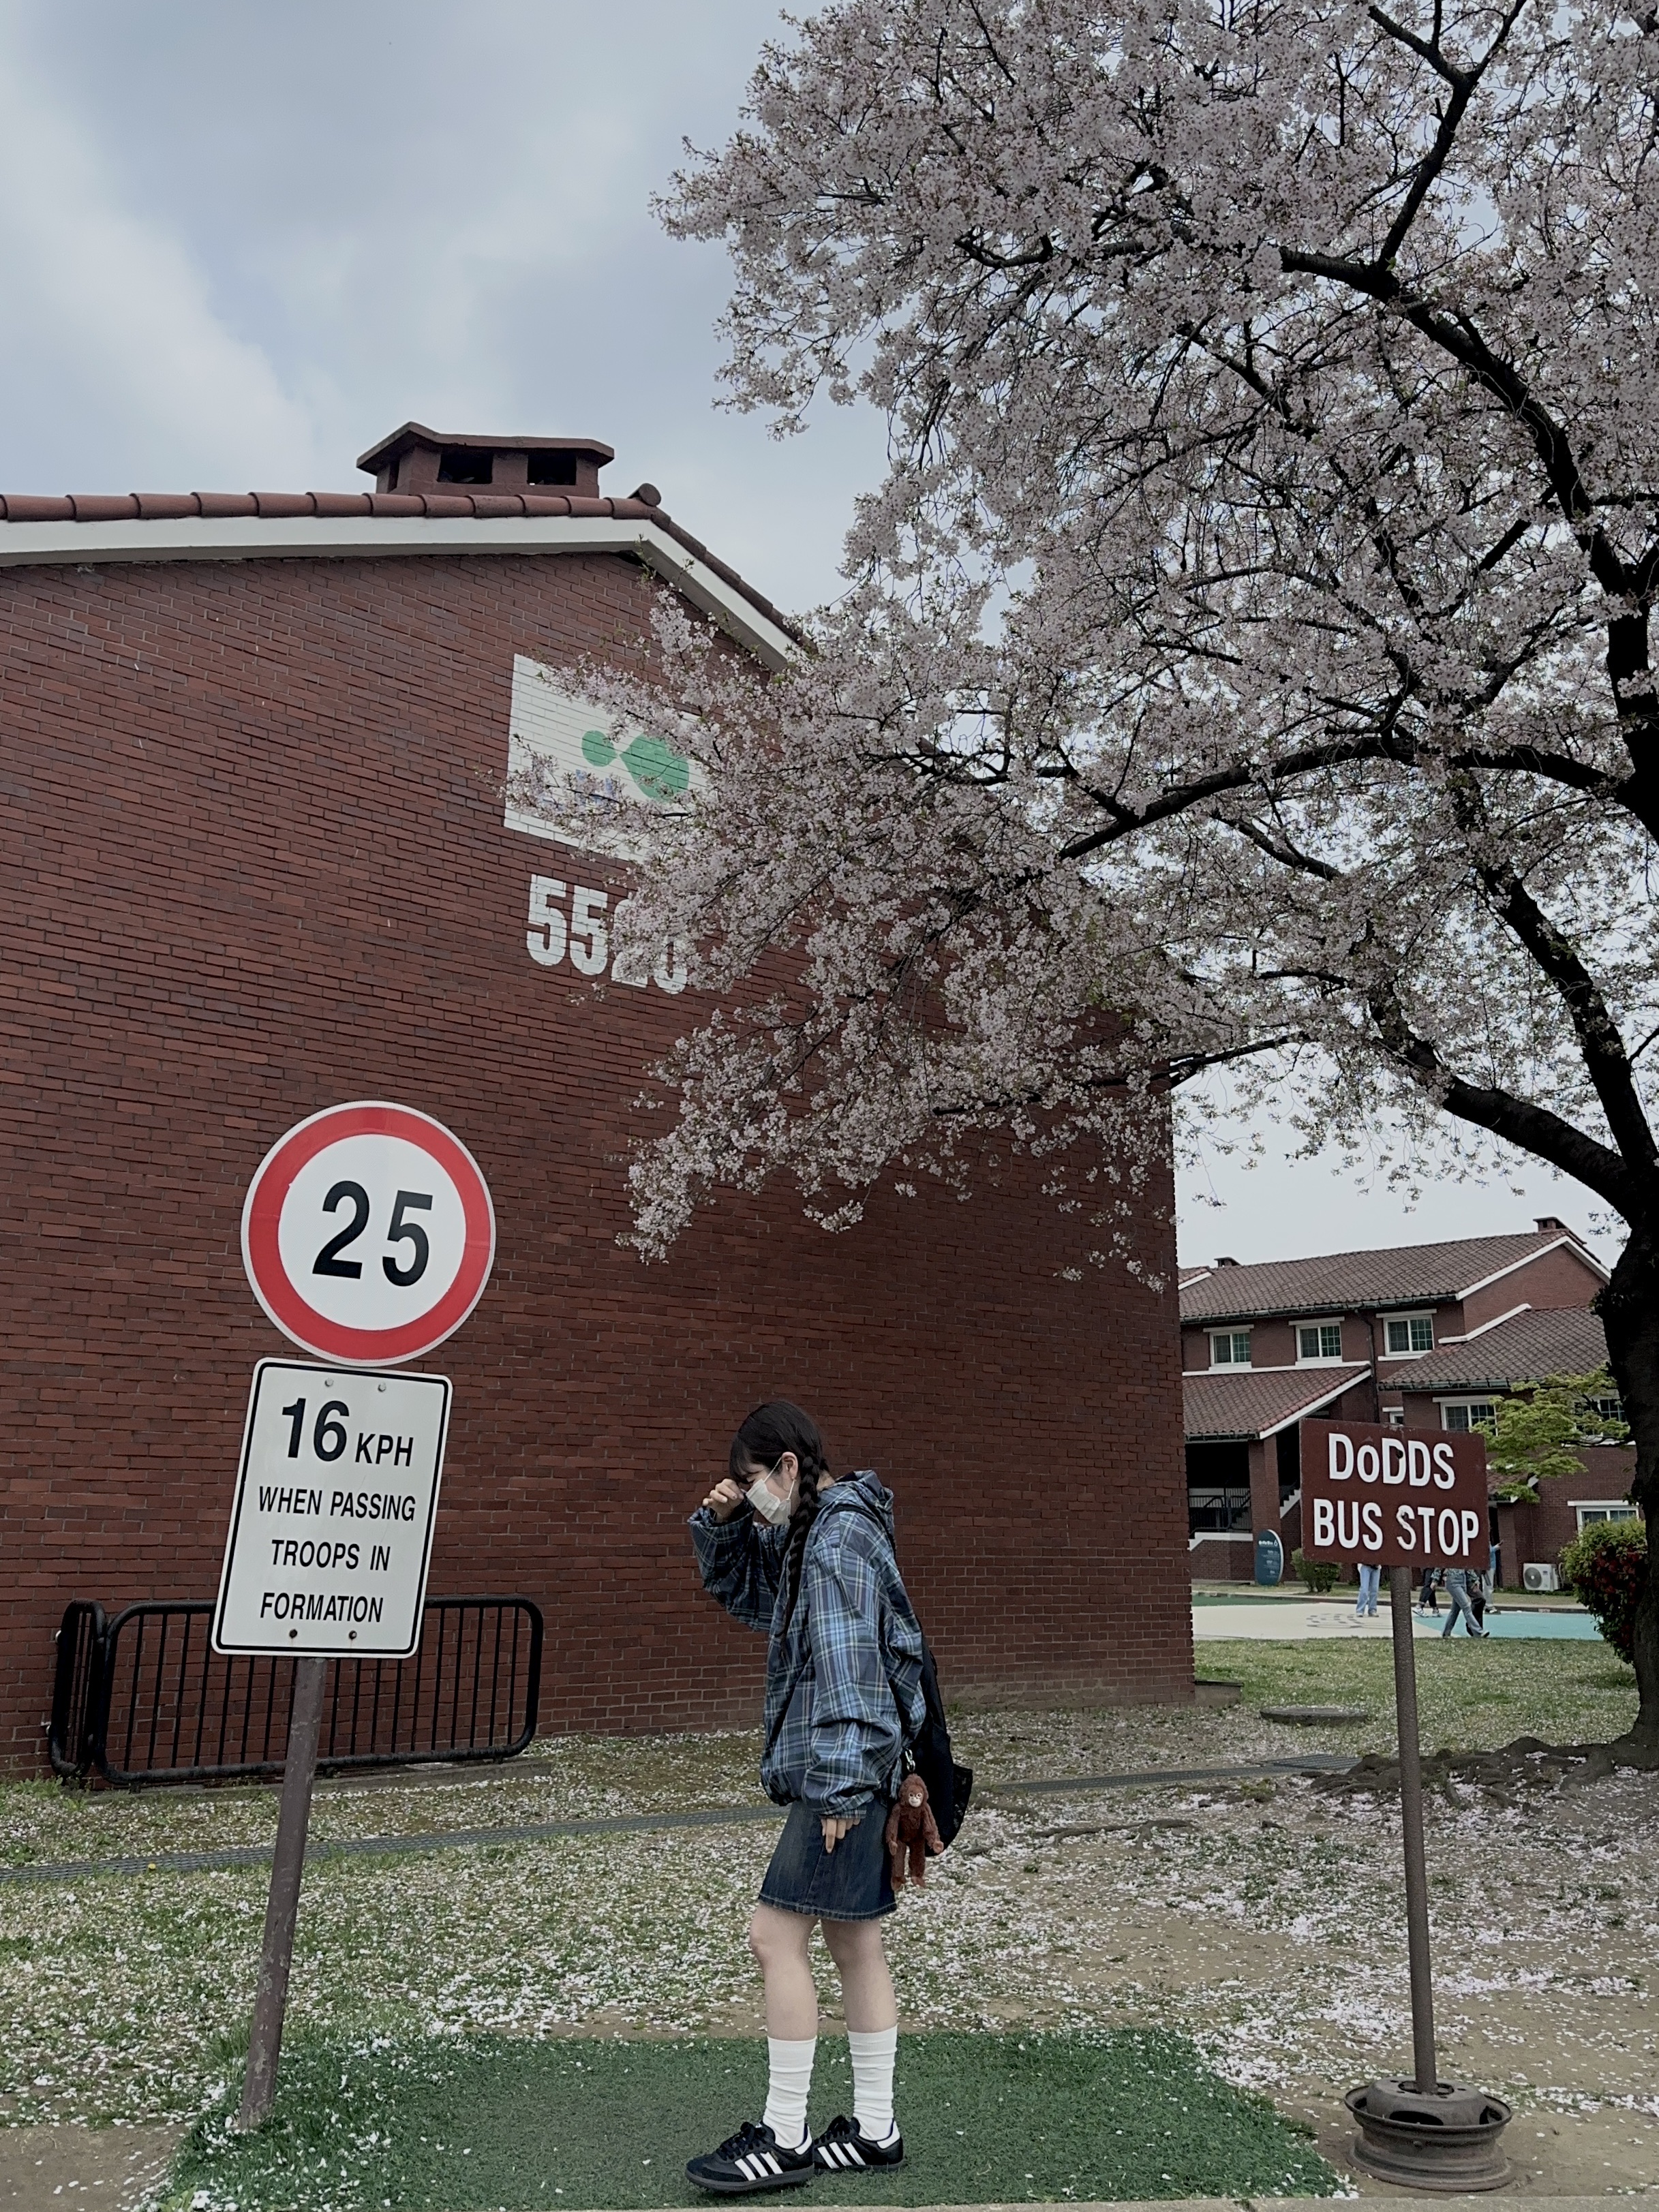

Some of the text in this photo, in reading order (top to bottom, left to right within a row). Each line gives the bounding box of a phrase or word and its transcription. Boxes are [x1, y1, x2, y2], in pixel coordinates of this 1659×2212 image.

[312, 1180, 433, 1287] 25
[281, 1398, 414, 1466] 16 KPH
[1328, 1432, 1456, 1490] DoDDS
[259, 1486, 416, 1521] WHEN PASSING
[1313, 1498, 1479, 1556] BUS STOP
[272, 1539, 391, 1571] TROOPS IN
[260, 1592, 383, 1623] FORMATION
